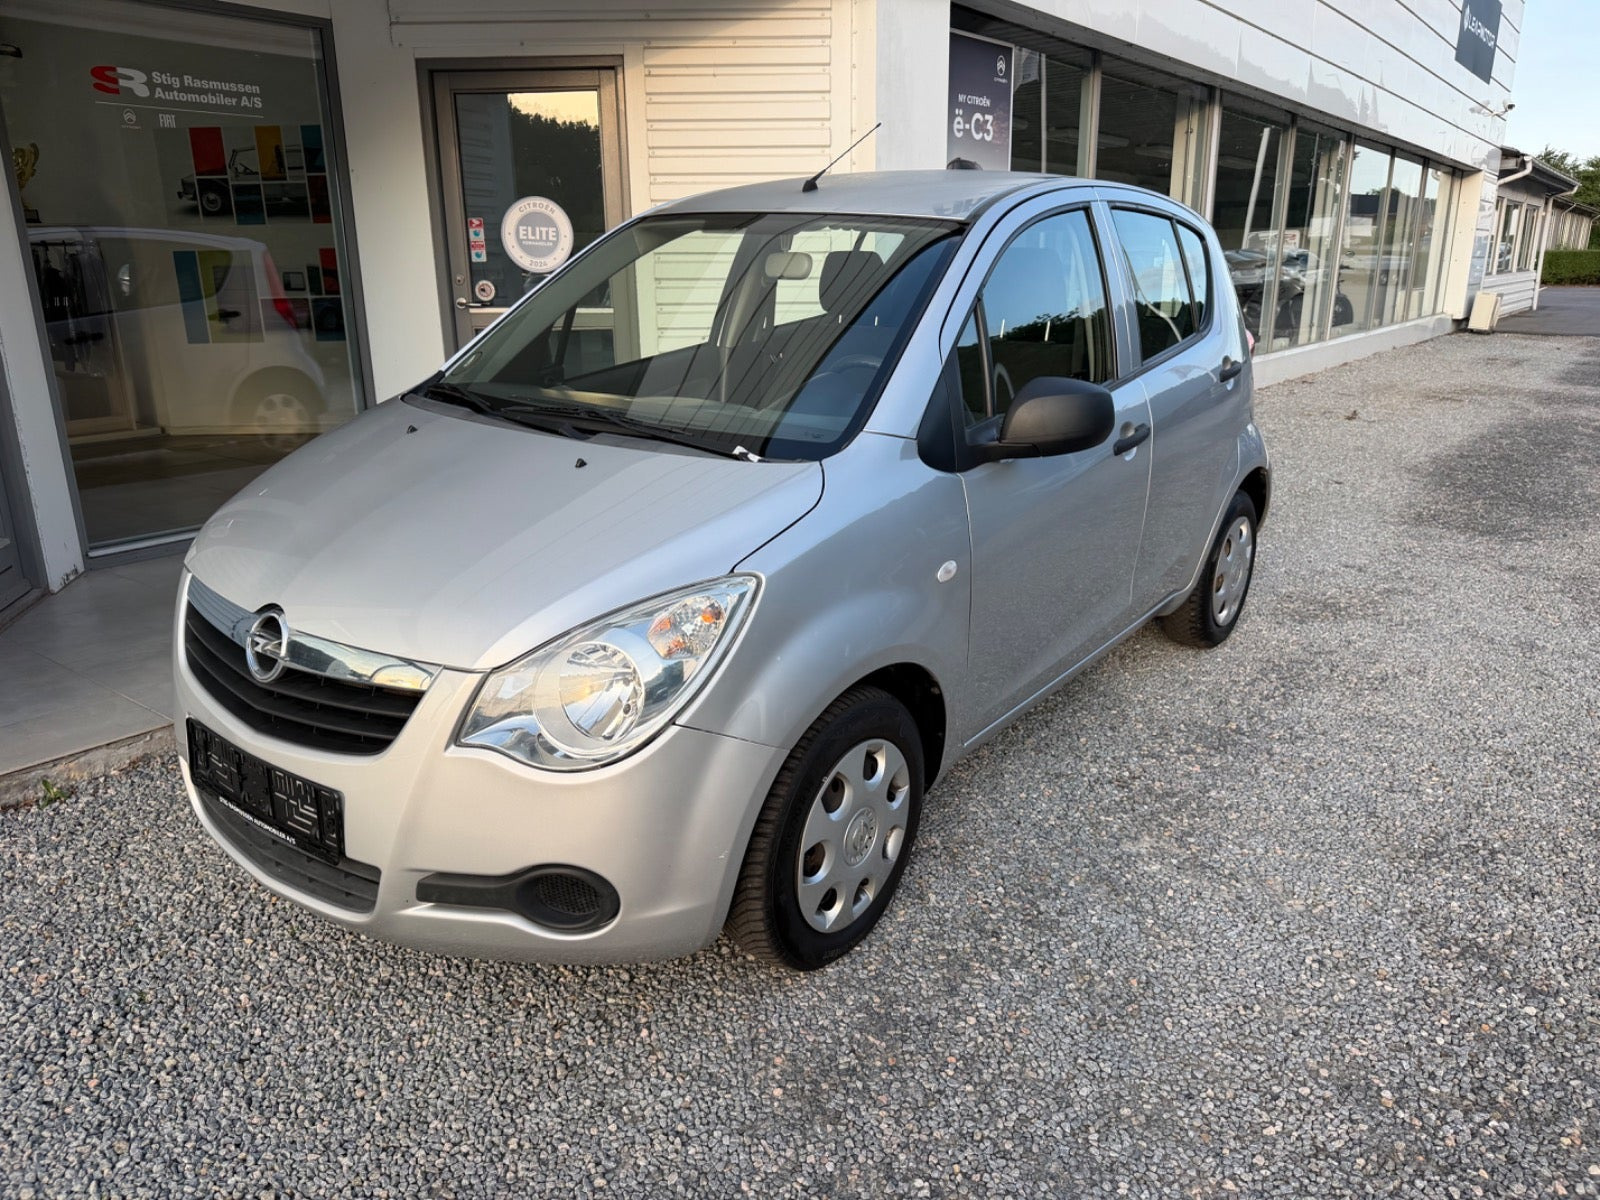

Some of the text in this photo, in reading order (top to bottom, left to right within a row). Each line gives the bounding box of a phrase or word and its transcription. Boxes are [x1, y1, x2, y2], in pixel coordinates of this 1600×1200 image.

[152, 71, 261, 94] Stig Rasmussen
[154, 87, 263, 109] Automobiler A/S
[966, 95, 991, 108] CITROËN
[158, 112, 176, 129] FIAT
[953, 108, 994, 141] ë-C3
[518, 201, 556, 215] CITROËN
[519, 225, 557, 241] ELITE
